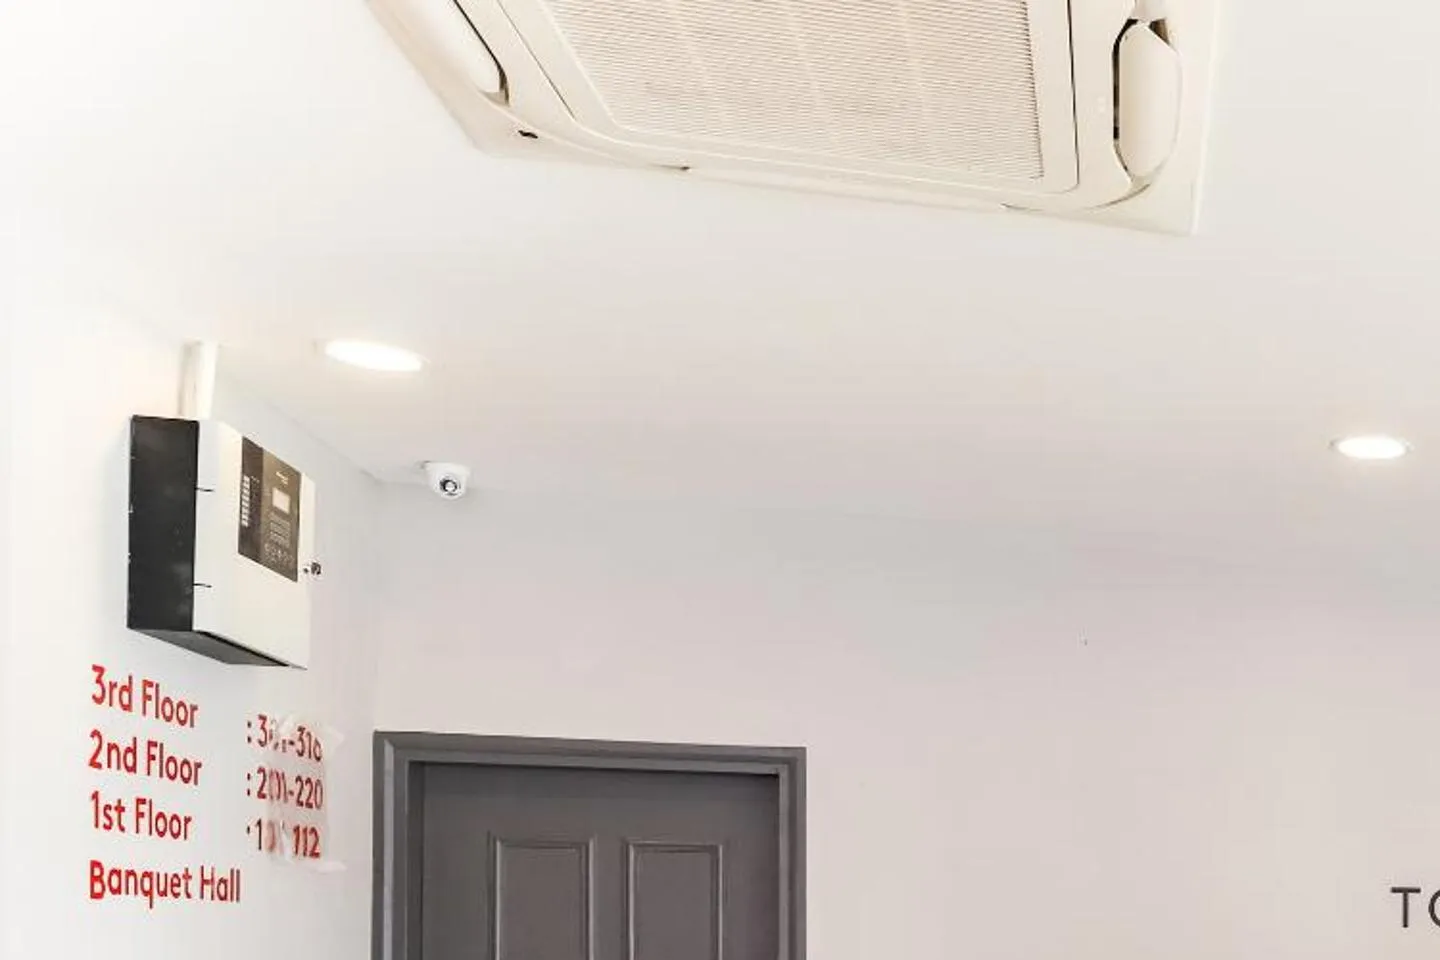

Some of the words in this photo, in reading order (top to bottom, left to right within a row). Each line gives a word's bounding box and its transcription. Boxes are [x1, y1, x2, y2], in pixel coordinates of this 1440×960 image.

[91, 664, 133, 712] 3rd
[142, 679, 198, 728] Floor
[89, 729, 137, 774] 2nd
[146, 739, 202, 786] Floor
[91, 790, 126, 833] 1st
[135, 797, 192, 840] Floor
[89, 860, 193, 909] Banquet
[200, 865, 241, 903] Hall
